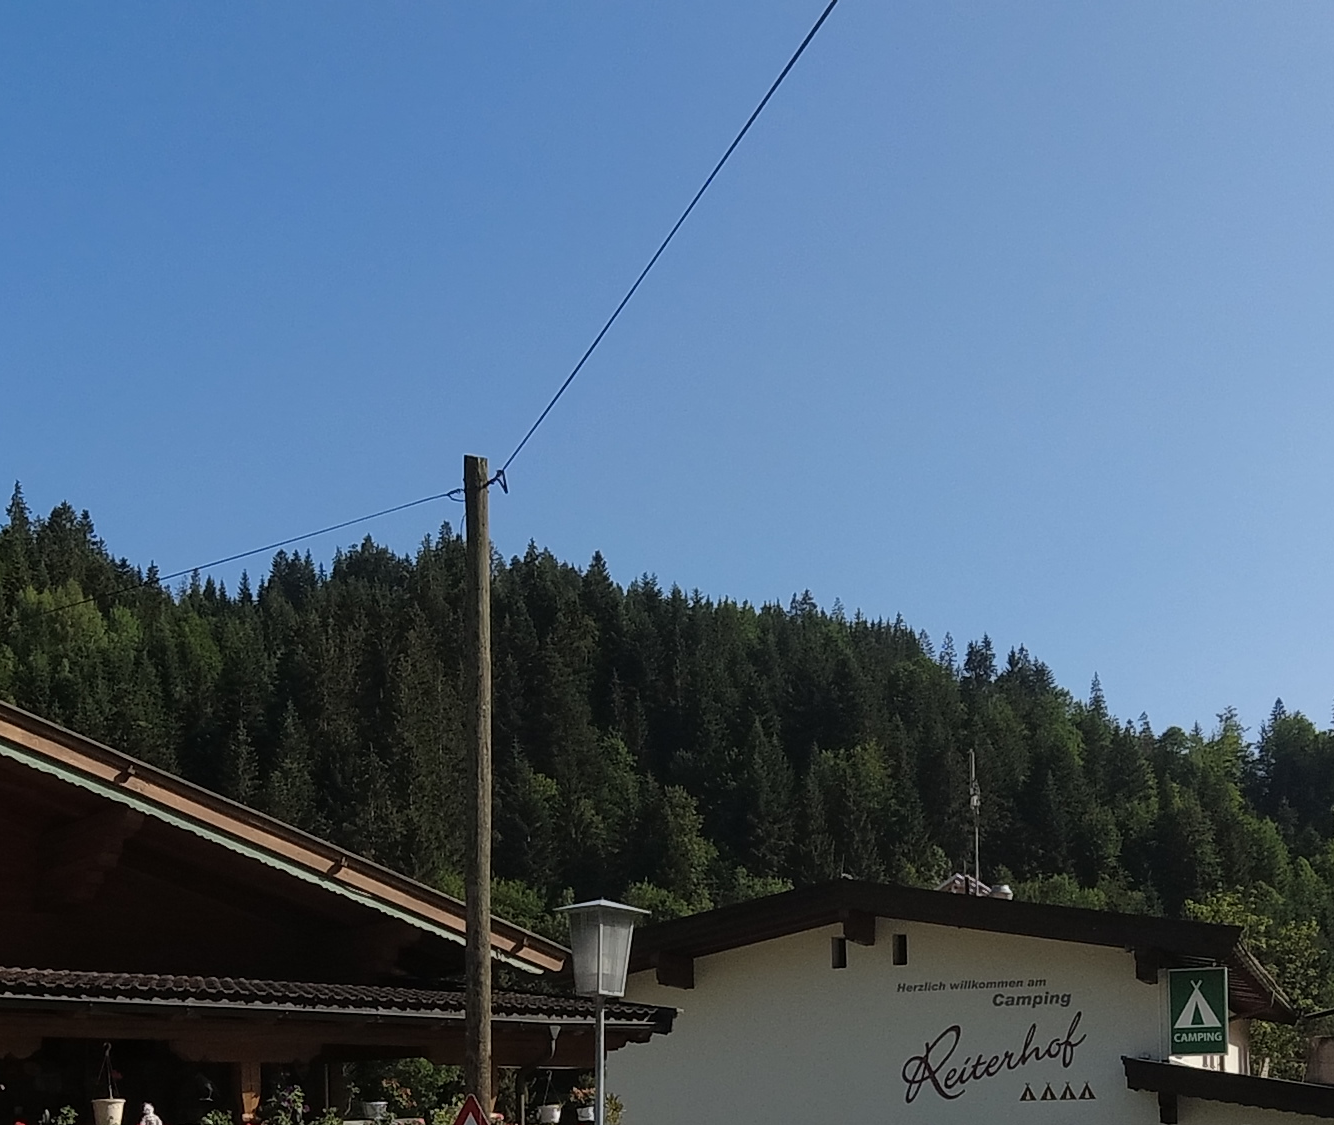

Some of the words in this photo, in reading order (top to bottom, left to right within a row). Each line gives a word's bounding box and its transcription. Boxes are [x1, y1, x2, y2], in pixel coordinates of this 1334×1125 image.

[897, 981, 946, 993] Herzlich
[949, 979, 1023, 991] willkommen
[1027, 978, 1047, 987] am
[992, 991, 1072, 1008] Camping
[1173, 1031, 1223, 1043] CAMPING
[902, 1011, 1087, 1104] Reiterhof
